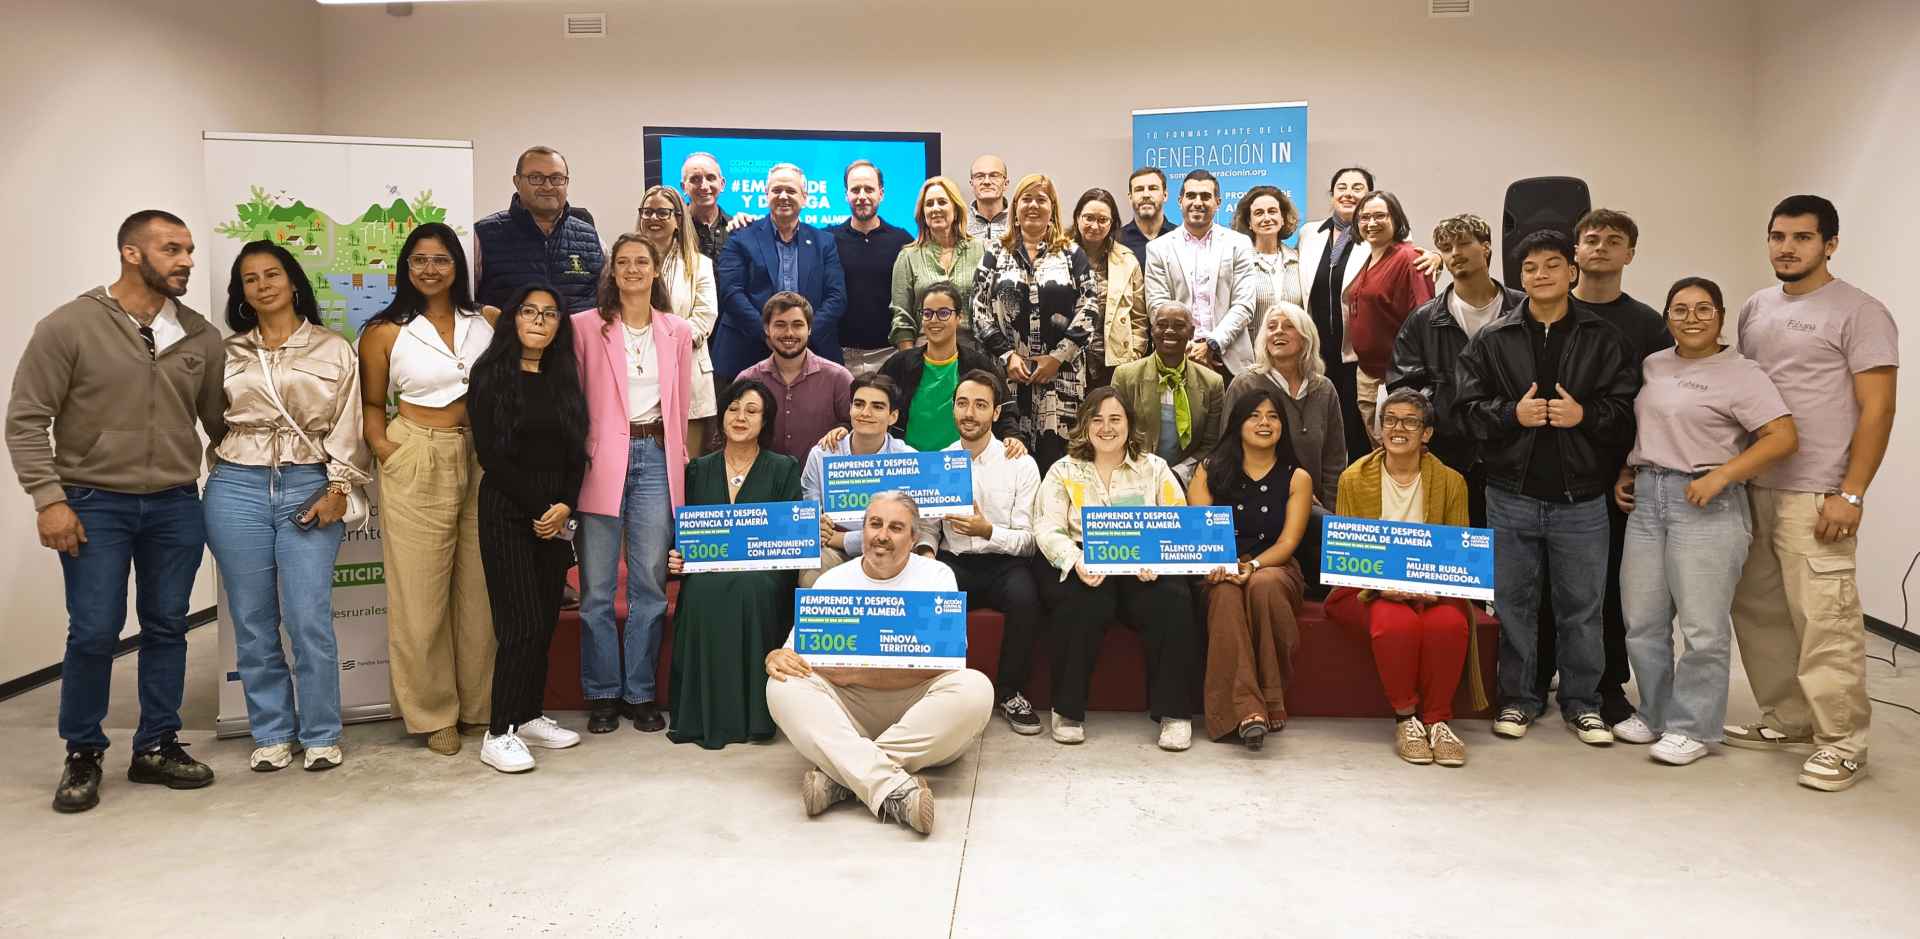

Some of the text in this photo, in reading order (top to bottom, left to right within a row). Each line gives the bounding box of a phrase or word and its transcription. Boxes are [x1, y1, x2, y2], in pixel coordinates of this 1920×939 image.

[1166, 129, 1209, 138] FORMAS
[1216, 127, 1252, 136] PARTE
[1260, 126, 1272, 134] DE
[1281, 125, 1292, 133] LA
[1145, 139, 1292, 168] GENERACIÓN IN
[731, 179, 827, 193] #EMDE
[742, 194, 753, 208] Y
[828, 458, 918, 470] #EMPRENDE Y DESPEGA
[828, 466, 920, 479] PROVINCIA DE ALMERÍA
[829, 493, 869, 508] 1300
[680, 508, 768, 520] #EMPRENDE Y DESPEGA
[1086, 512, 1179, 520] #EMPRENDE Y DESPEGA
[680, 516, 768, 529] PROVINCIA DE ALMERÍA
[1086, 519, 1181, 529] PROVINCIA DE ALMERÍA
[1328, 521, 1432, 538] #EMPRENDE Y DESPEGA
[747, 539, 815, 549] EMPRENDIMIENTO
[1327, 530, 1377, 543] PROVINCIA
[1379, 535, 1391, 544] DE
[1393, 537, 1433, 548] ALMERÍA
[680, 543, 729, 560] 1300€
[747, 547, 801, 558] CON IMPACTO
[1088, 544, 1141, 561] 1300€
[1160, 544, 1224, 552] TALENTO JOVEN
[1160, 552, 1203, 561] FEMENINO
[1326, 555, 1384, 575] 1300€
[1406, 561, 1469, 575] MUJER RURAL
[1406, 570, 1480, 584] EMPRENDEDORA
[800, 595, 905, 606] #EMPRENDE Y DESPEGA
[800, 605, 906, 617] PROVINCIA DE ALMERÍA
[799, 633, 858, 651] 1300€
[880, 634, 917, 644] INNOVA
[880, 644, 931, 653] TERRITORIO
